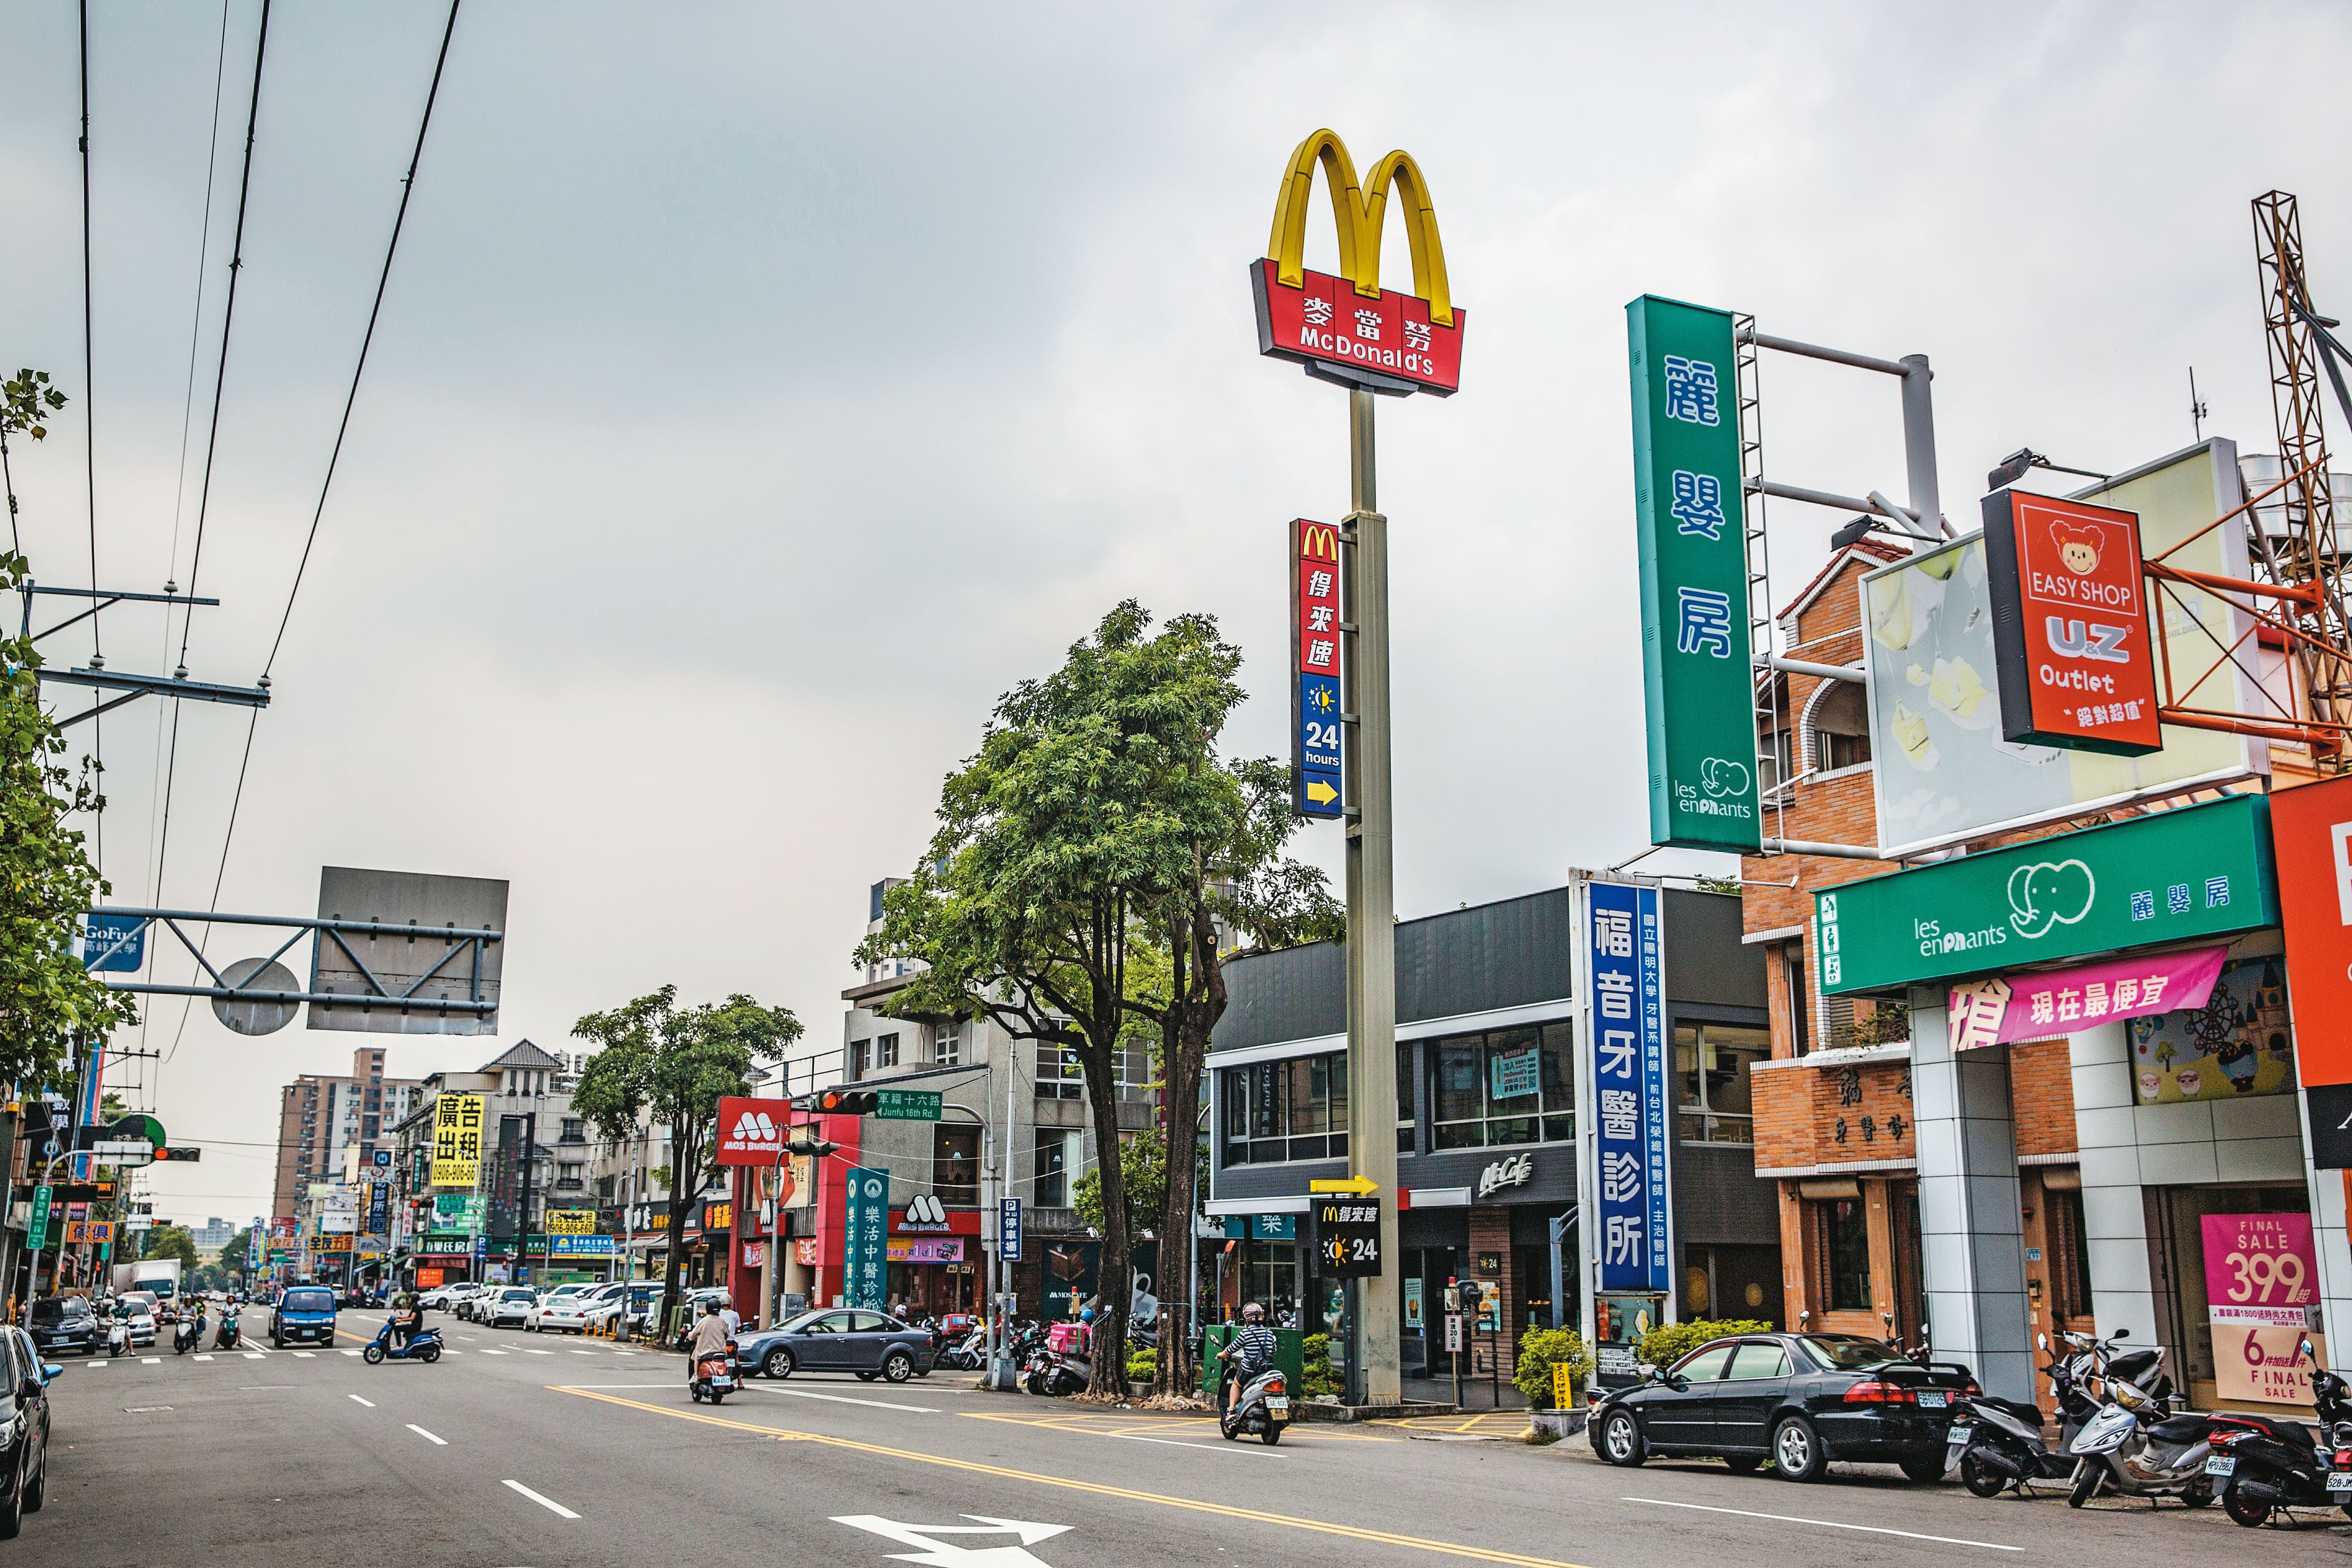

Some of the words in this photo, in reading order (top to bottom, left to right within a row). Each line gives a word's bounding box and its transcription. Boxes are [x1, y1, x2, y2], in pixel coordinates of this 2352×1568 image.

[1303, 297, 1431, 352] 麥當勞
[1300, 326, 1433, 376] McDonald's
[1664, 354, 1731, 659] 麗嬰房
[2032, 571, 2077, 599] EASY
[2081, 579, 2132, 607] SHOP
[1306, 570, 1336, 667] 得來速
[2040, 665, 2115, 694] Outlet
[1305, 722, 1339, 750] 24
[1305, 750, 1340, 767] hours
[1675, 780, 1697, 798] les
[2131, 875, 2230, 921] 麗嬰房
[1914, 918, 1940, 940] les
[2030, 975, 2169, 1025] 現在最便宜
[1595, 909, 1642, 1267] 福音牙醫診所
[878, 1093, 940, 1106] 軍福十六路
[437, 1097, 481, 1128] 廣告
[883, 1107, 904, 1117] Junfu
[906, 1108, 921, 1117] 16th
[922, 1109, 934, 1118] Rd.
[436, 1131, 479, 1161] 出租
[723, 1140, 746, 1150] MOS
[434, 1164, 479, 1180] 0906-906-66
[1008, 1201, 1014, 1210] P
[1338, 1206, 1378, 1222] 得來速
[897, 1223, 918, 1231] MOS
[1005, 1218, 1017, 1252] 停車場
[2240, 1221, 2283, 1232] FINAL
[310, 1236, 353, 1251] 全友五金
[478, 1237, 486, 1246] P
[1352, 1238, 1378, 1261] 24
[2237, 1234, 2289, 1250] SALE
[1488, 1258, 1498, 1269] 24
[2251, 1370, 2309, 1387] FINAL
[2265, 1387, 2296, 1398] SALE
